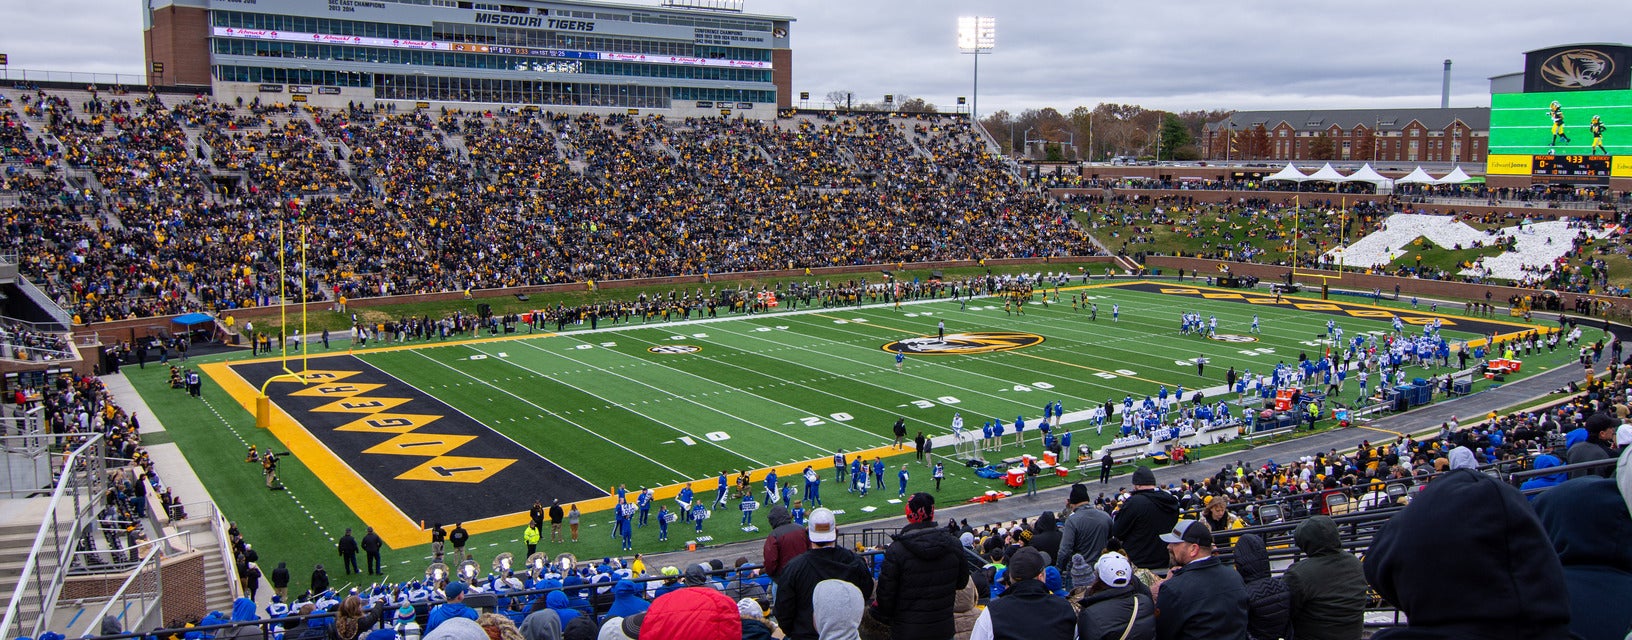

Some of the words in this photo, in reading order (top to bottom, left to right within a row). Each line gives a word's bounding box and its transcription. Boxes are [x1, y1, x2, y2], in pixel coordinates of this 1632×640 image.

[476, 13, 542, 27] MISSOURI
[548, 19, 595, 31] TIGERS
[1092, 369, 1138, 379] 50
[1013, 381, 1055, 392] 40
[910, 396, 962, 409] 30
[298, 372, 484, 478] TIGERS
[800, 412, 854, 427] 20
[675, 431, 732, 446] 10
[1016, 475, 1022, 483] G
